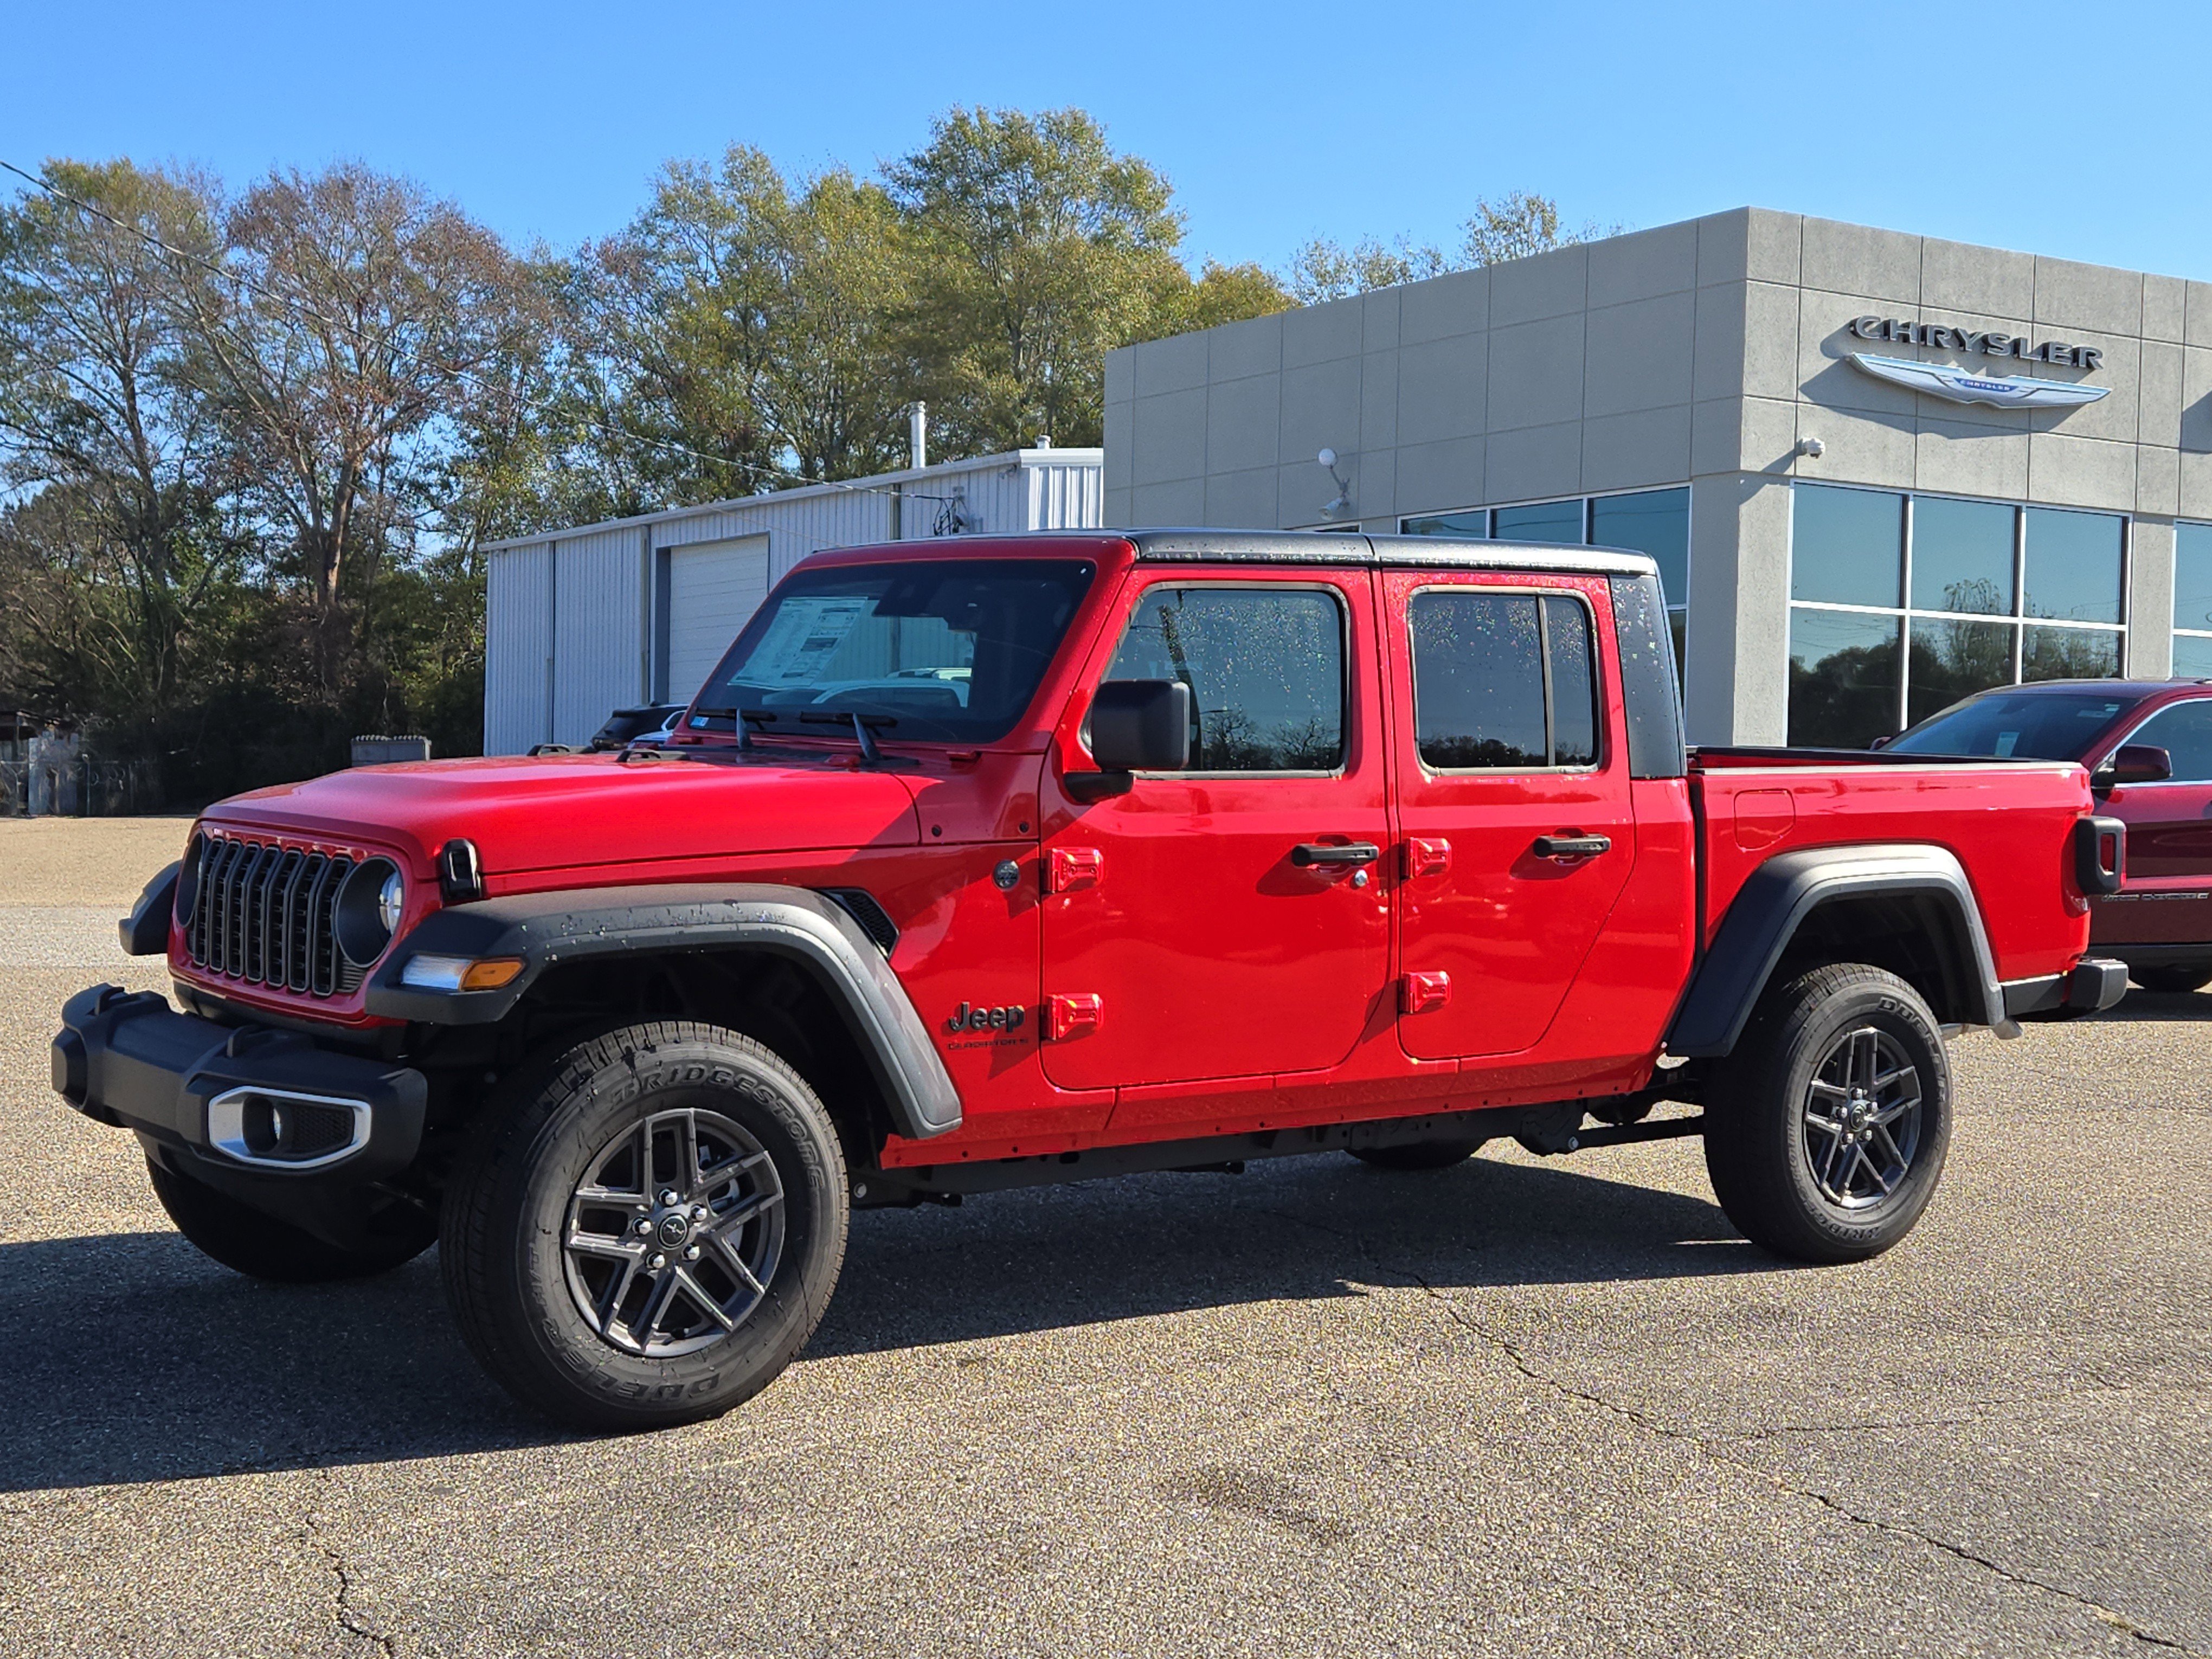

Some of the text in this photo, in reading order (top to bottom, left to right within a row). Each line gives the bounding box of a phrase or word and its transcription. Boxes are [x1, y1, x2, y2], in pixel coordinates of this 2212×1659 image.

[1850, 315, 2104, 369] CHRYSLER
[949, 1001, 1025, 1032] Jeep
[610, 1064, 826, 1190] BRIDGESTONE
[543, 1315, 721, 1400] DUELER
